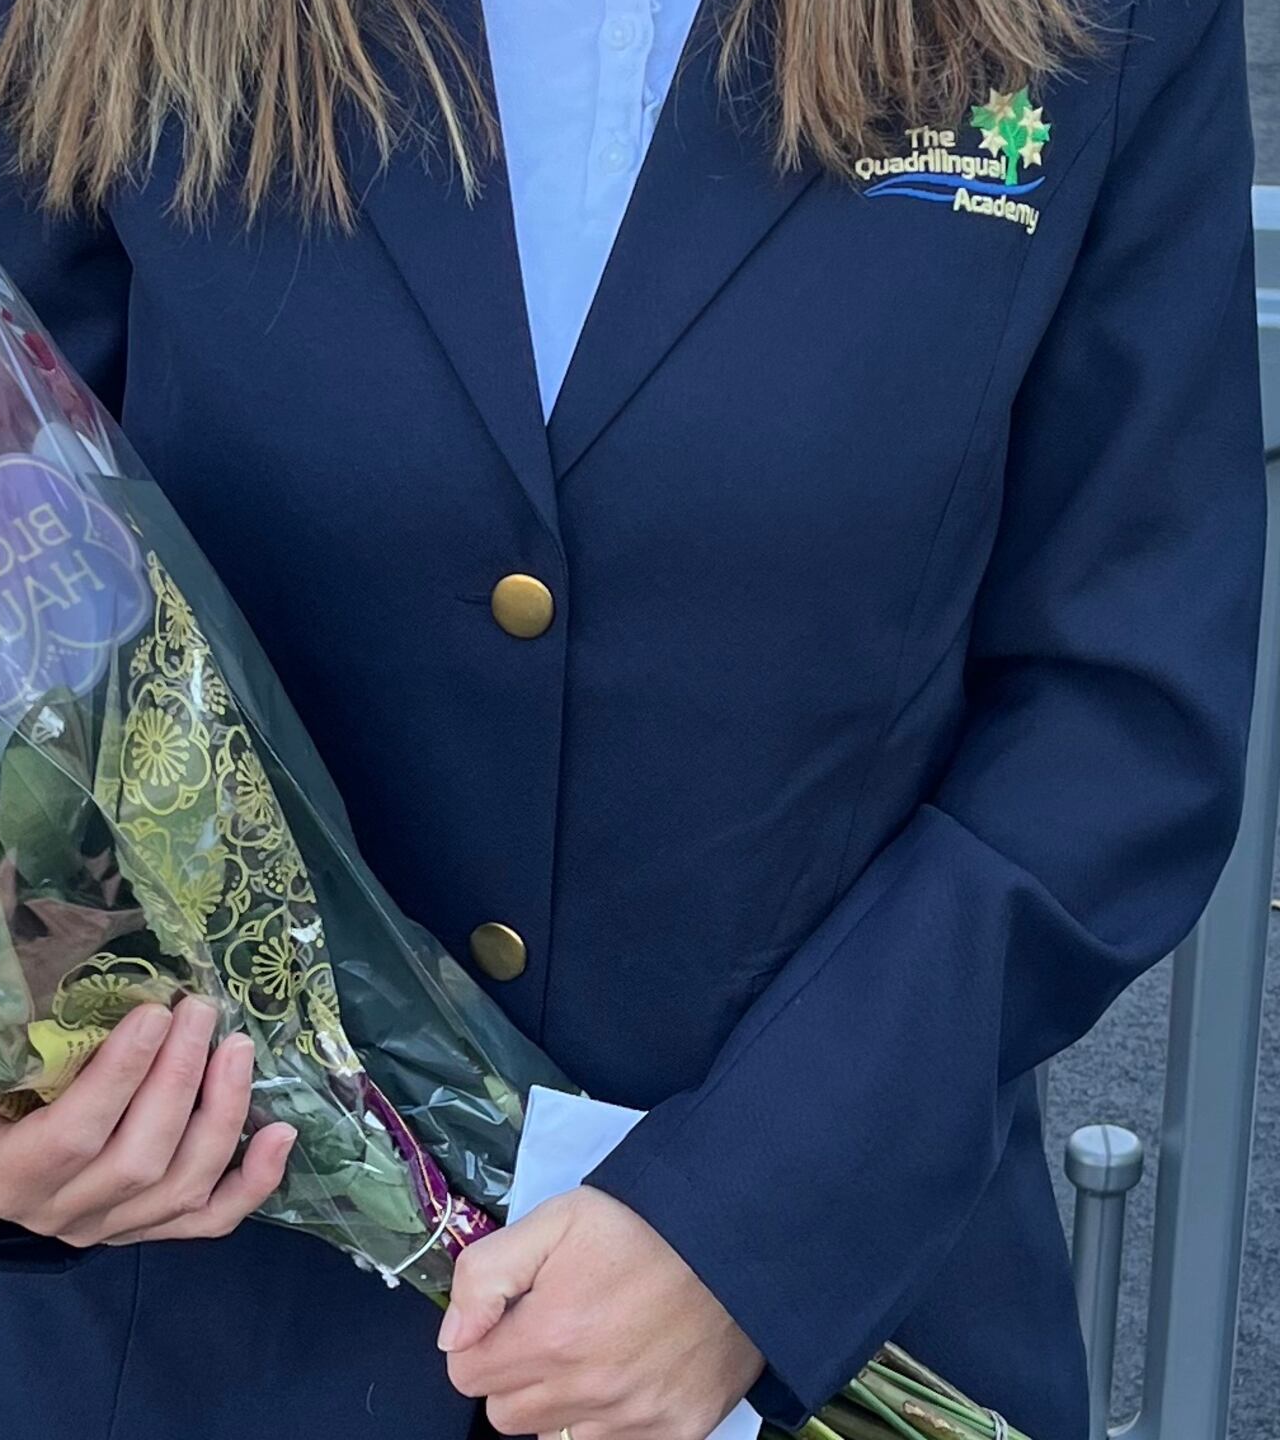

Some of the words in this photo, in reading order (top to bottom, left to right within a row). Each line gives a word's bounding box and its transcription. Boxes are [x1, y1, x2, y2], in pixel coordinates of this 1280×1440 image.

[904, 124, 956, 148] The
[855, 148, 1007, 180] Quadrilingual
[953, 187, 1040, 235] Academy
